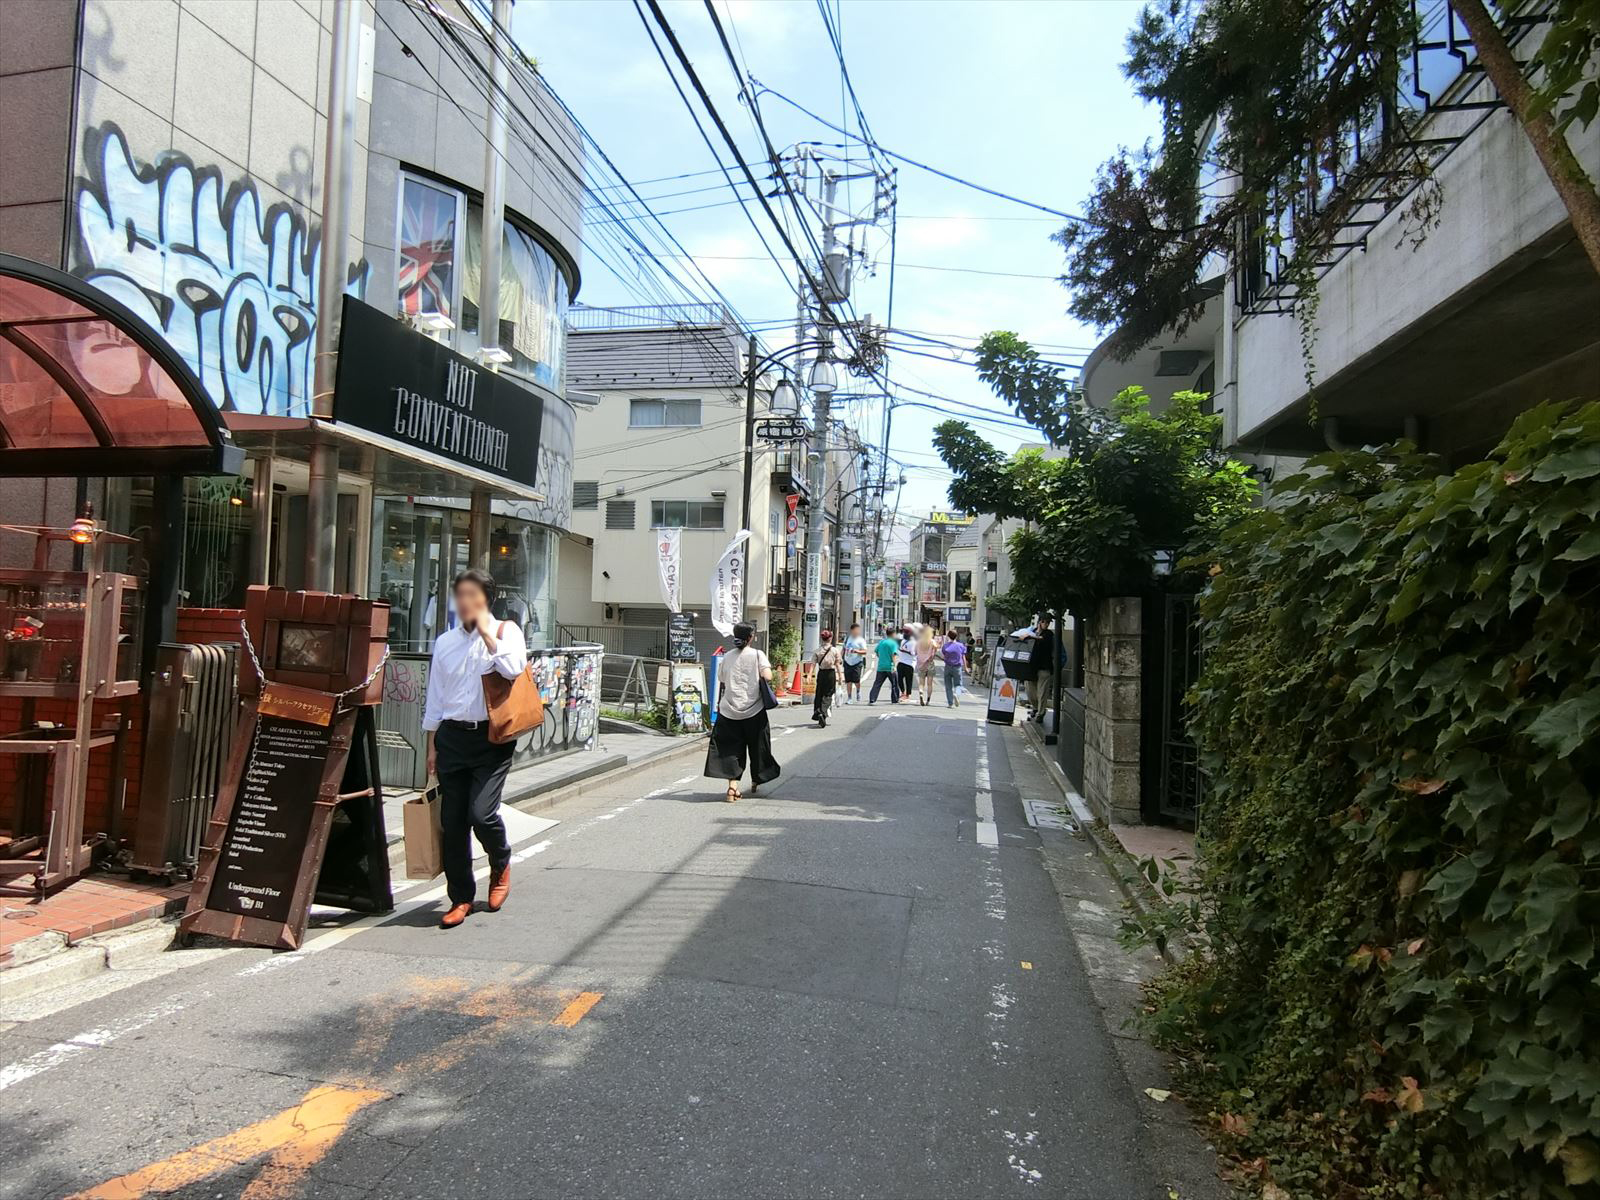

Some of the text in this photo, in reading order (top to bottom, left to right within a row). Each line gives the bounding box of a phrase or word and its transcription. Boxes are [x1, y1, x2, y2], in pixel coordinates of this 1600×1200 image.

[446, 359, 478, 411] NOT
[394, 387, 509, 472] CONVENTIONAL
[279, 727, 302, 735] ABSTRACT
[244, 827, 264, 836] Traditional
[228, 881, 281, 897] Underground Floor
[255, 900, 264, 909] B1
